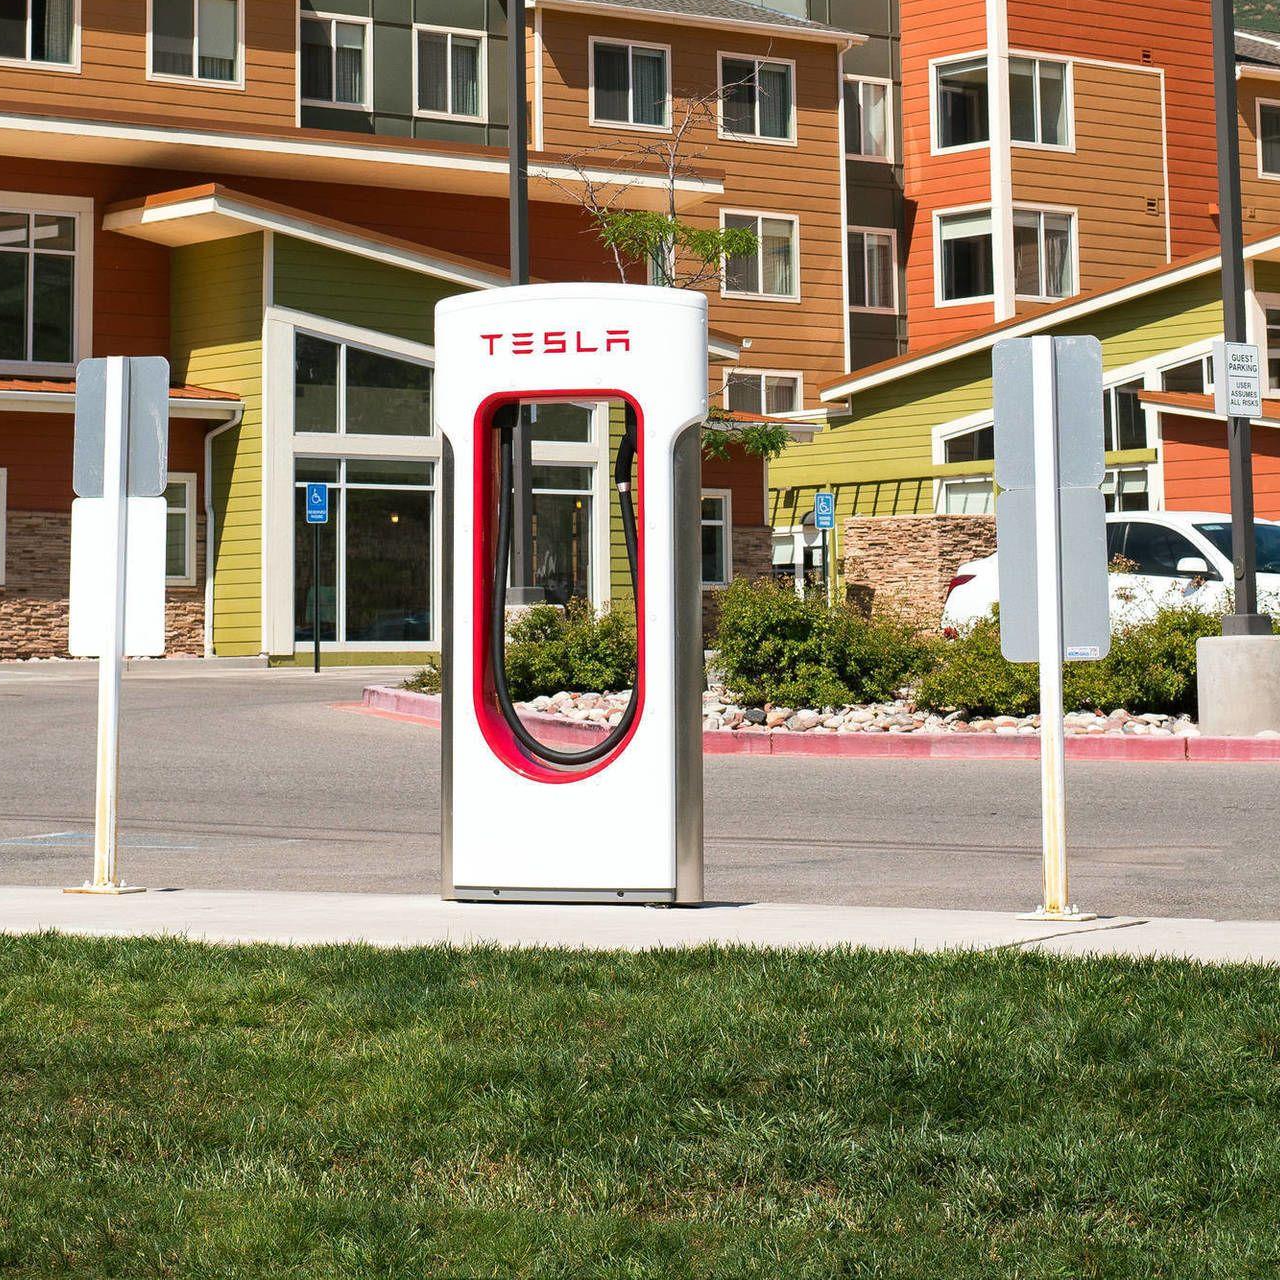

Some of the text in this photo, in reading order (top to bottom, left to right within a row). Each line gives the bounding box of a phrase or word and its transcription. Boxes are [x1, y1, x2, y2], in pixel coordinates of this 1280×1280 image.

[480, 329, 631, 357] TESLA
[1231, 353, 1254, 363] GUEST
[1228, 362, 1258, 373] PARKING
[1236, 381, 1252, 390] USER
[1231, 391, 1258, 399] ASSUMES
[1230, 398, 1259, 408] ALL RISKS
